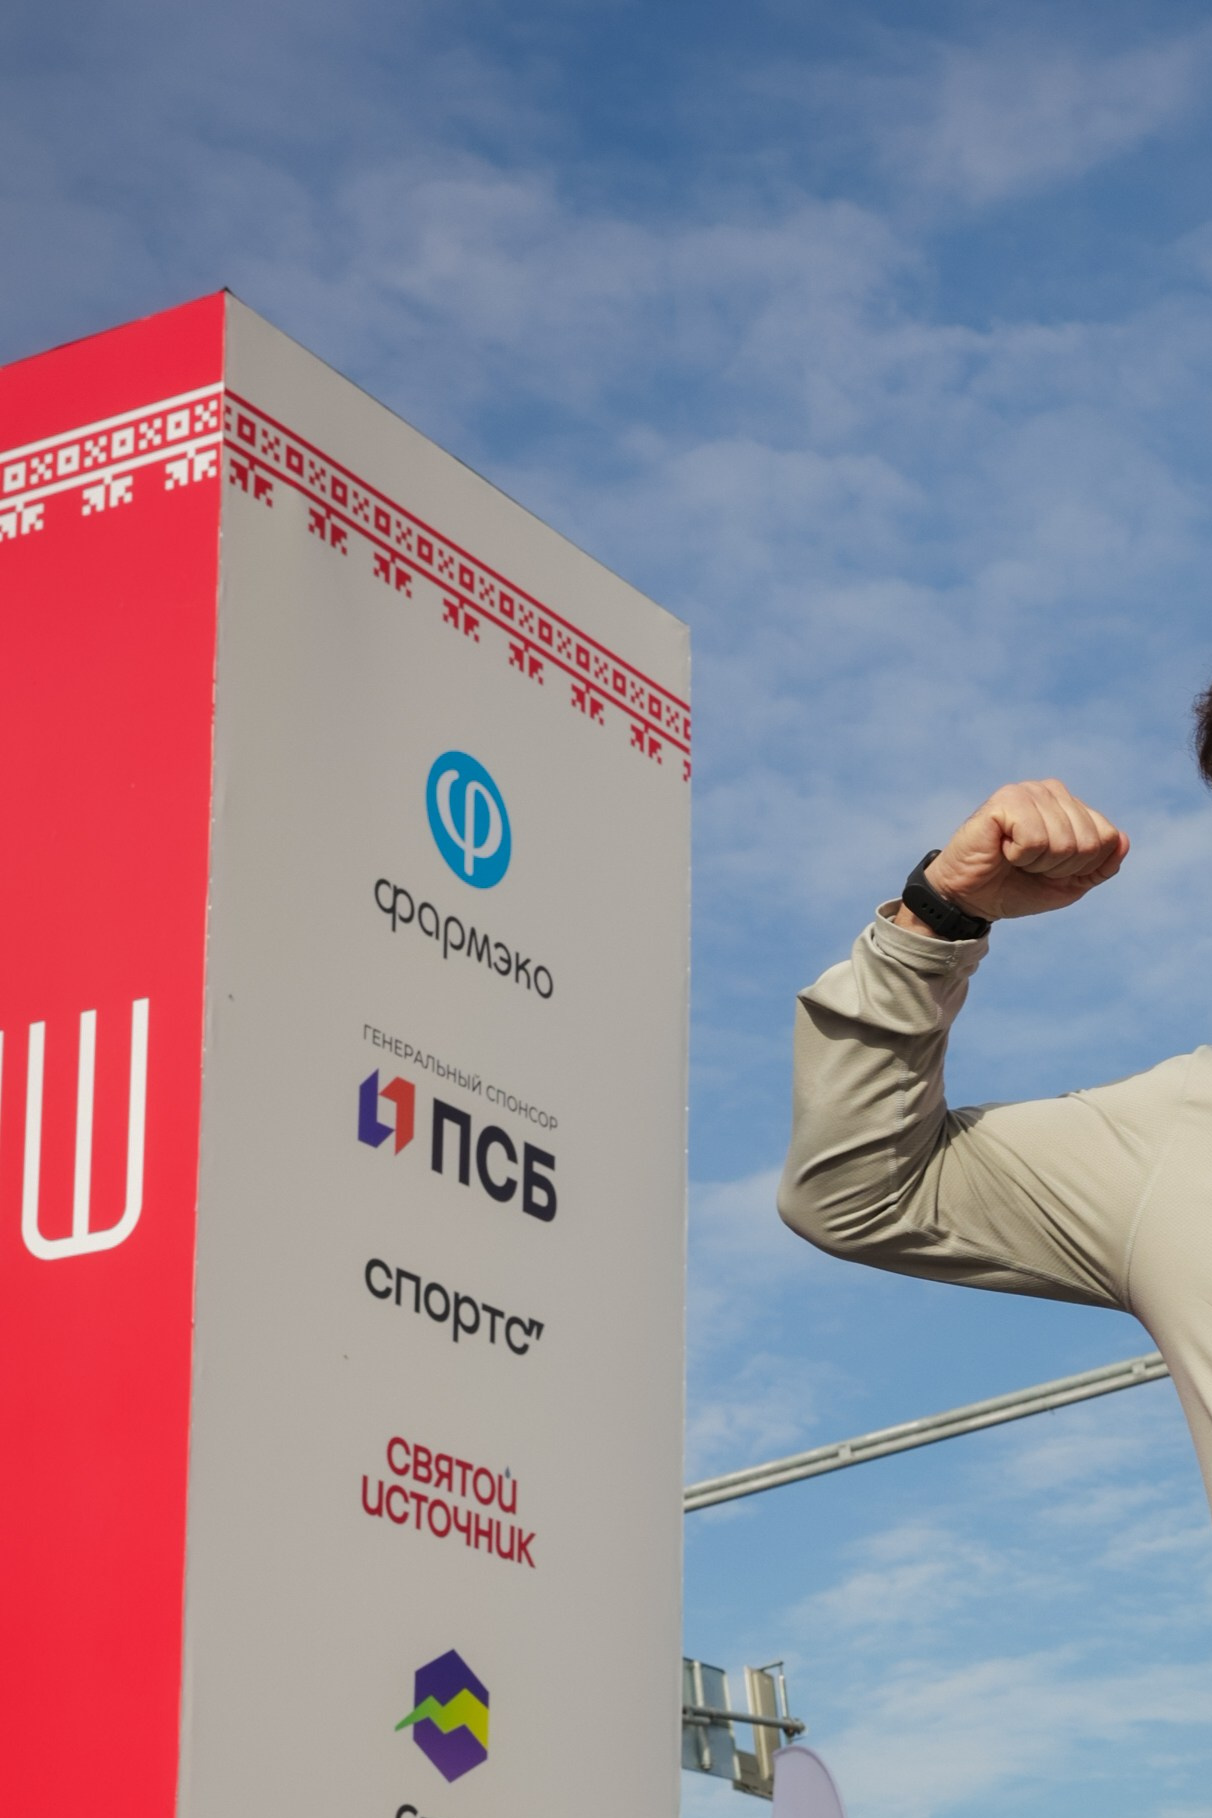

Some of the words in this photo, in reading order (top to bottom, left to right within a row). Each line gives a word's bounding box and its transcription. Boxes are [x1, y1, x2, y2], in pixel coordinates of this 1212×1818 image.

[374, 878, 553, 998] фармэко
[0, 998, 149, 1260] Ш
[363, 1024, 482, 1095] ГЕНЕРАЛЬНЫЙ
[486, 1085, 558, 1132] СПОНСОР
[431, 1097, 557, 1222] ПСБ
[362, 1475, 536, 1568] ИСТОЧНИК
[386, 1436, 518, 1514] СВЯТОЙ
